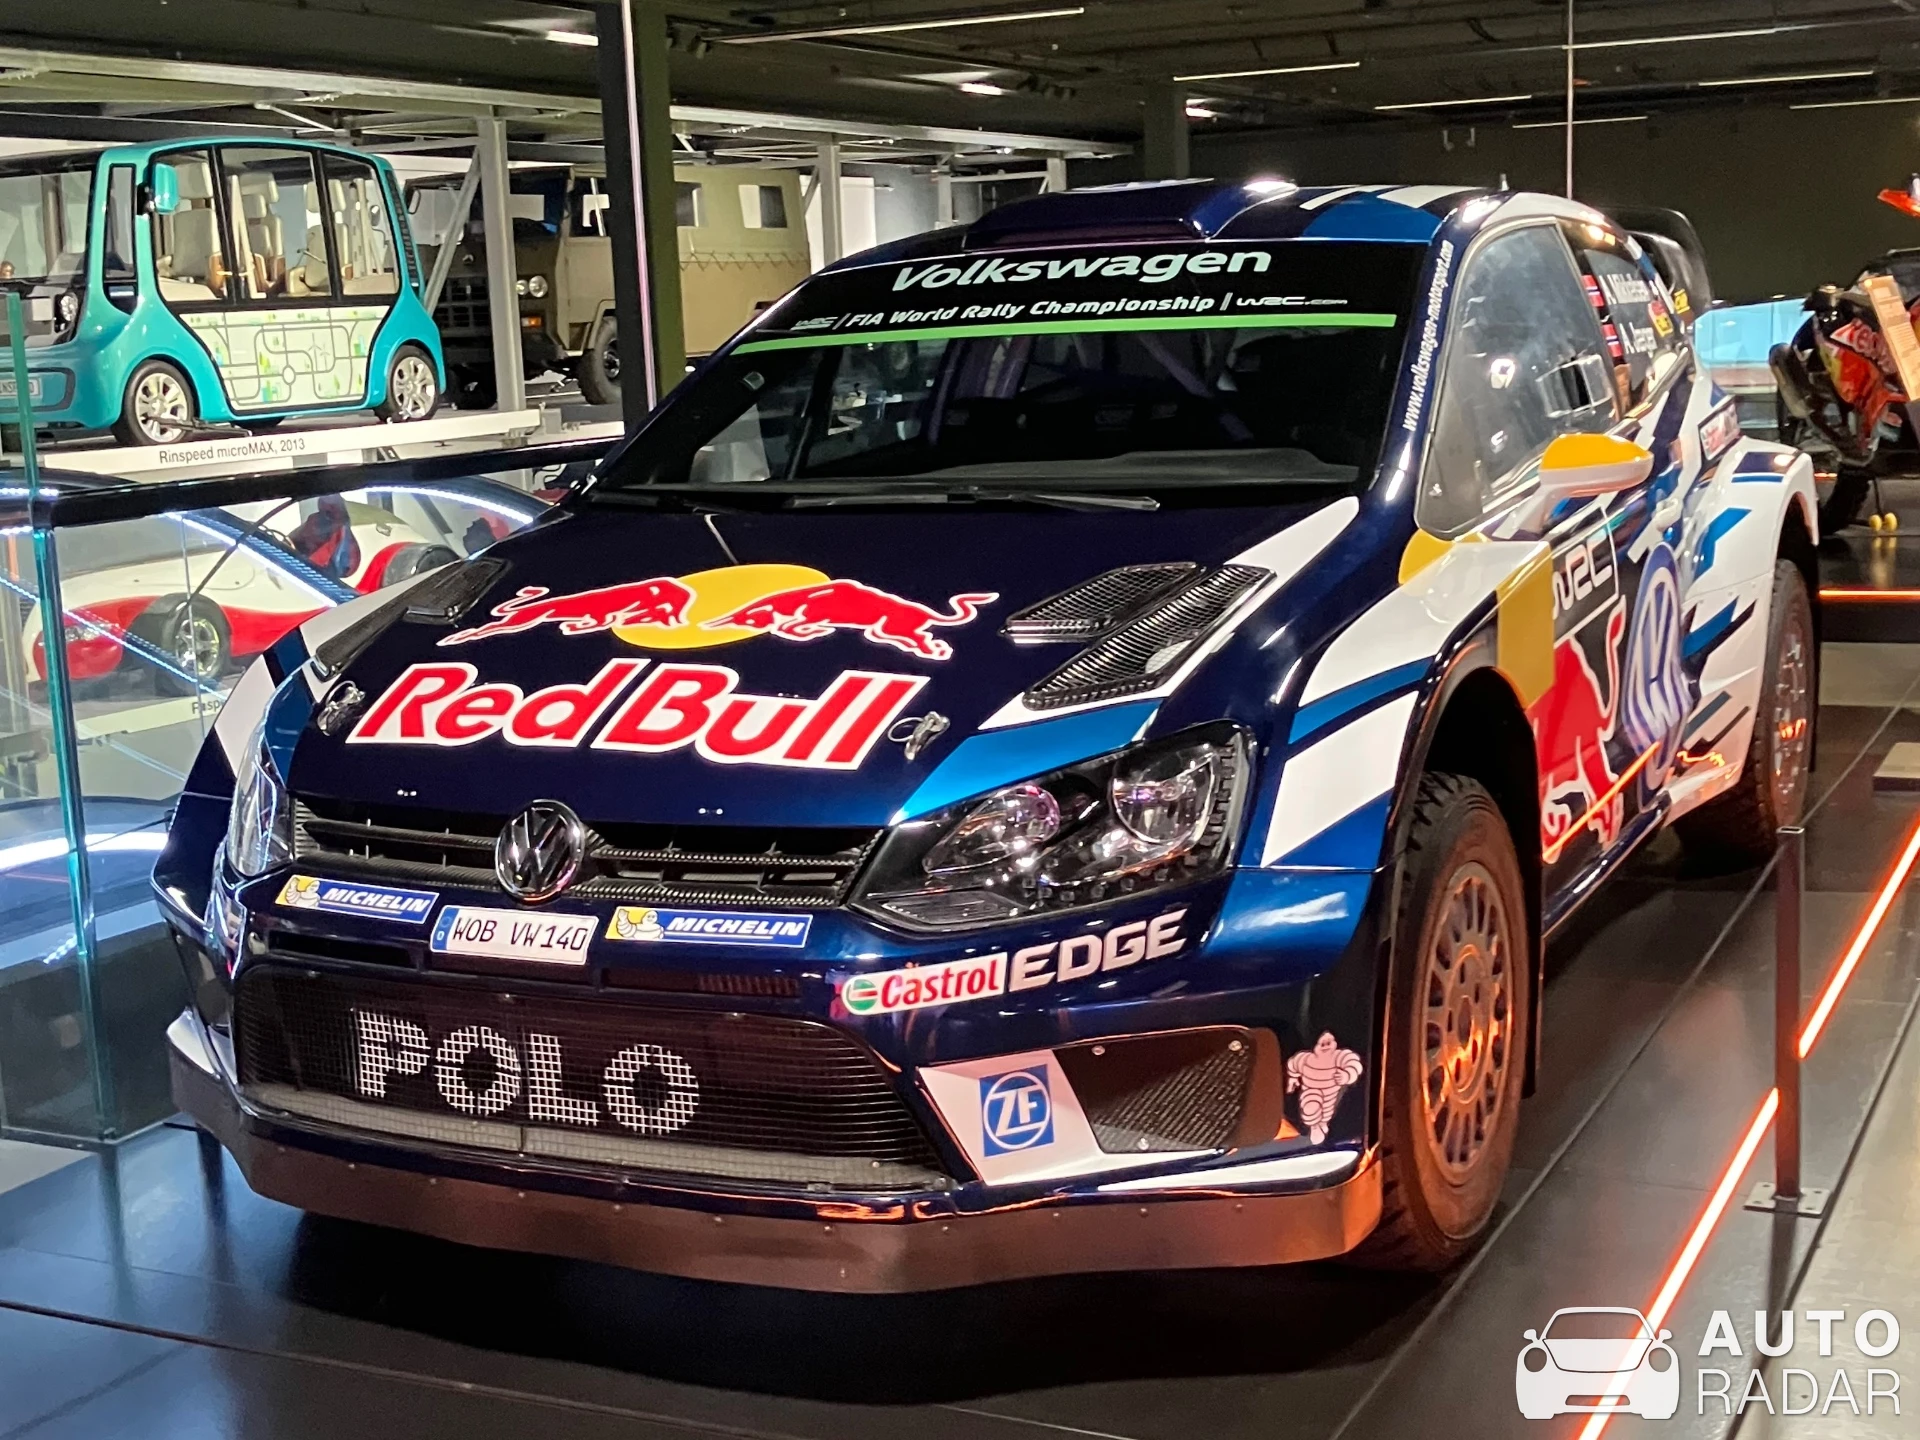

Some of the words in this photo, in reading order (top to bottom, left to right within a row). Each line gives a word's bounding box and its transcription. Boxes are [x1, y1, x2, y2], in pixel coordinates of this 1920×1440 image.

[892, 250, 1272, 292] Volkswagen
[845, 313, 882, 327] FIA
[889, 307, 959, 324] World
[961, 303, 1025, 321] Rally
[1029, 294, 1215, 316] Championship
[159, 446, 214, 465] Rinspeed
[217, 440, 279, 459] microMAX,
[280, 437, 306, 452] 2013
[347, 658, 651, 748] Red
[591, 664, 930, 770] Bull
[321, 887, 431, 913] MICHELIN
[453, 916, 498, 942] WOB
[665, 915, 806, 938] MICHELIN
[881, 958, 1000, 1008] Castrol
[1009, 908, 1188, 992] EDGE
[354, 1008, 700, 1135] POLO
[996, 1089, 1039, 1137] ZF
